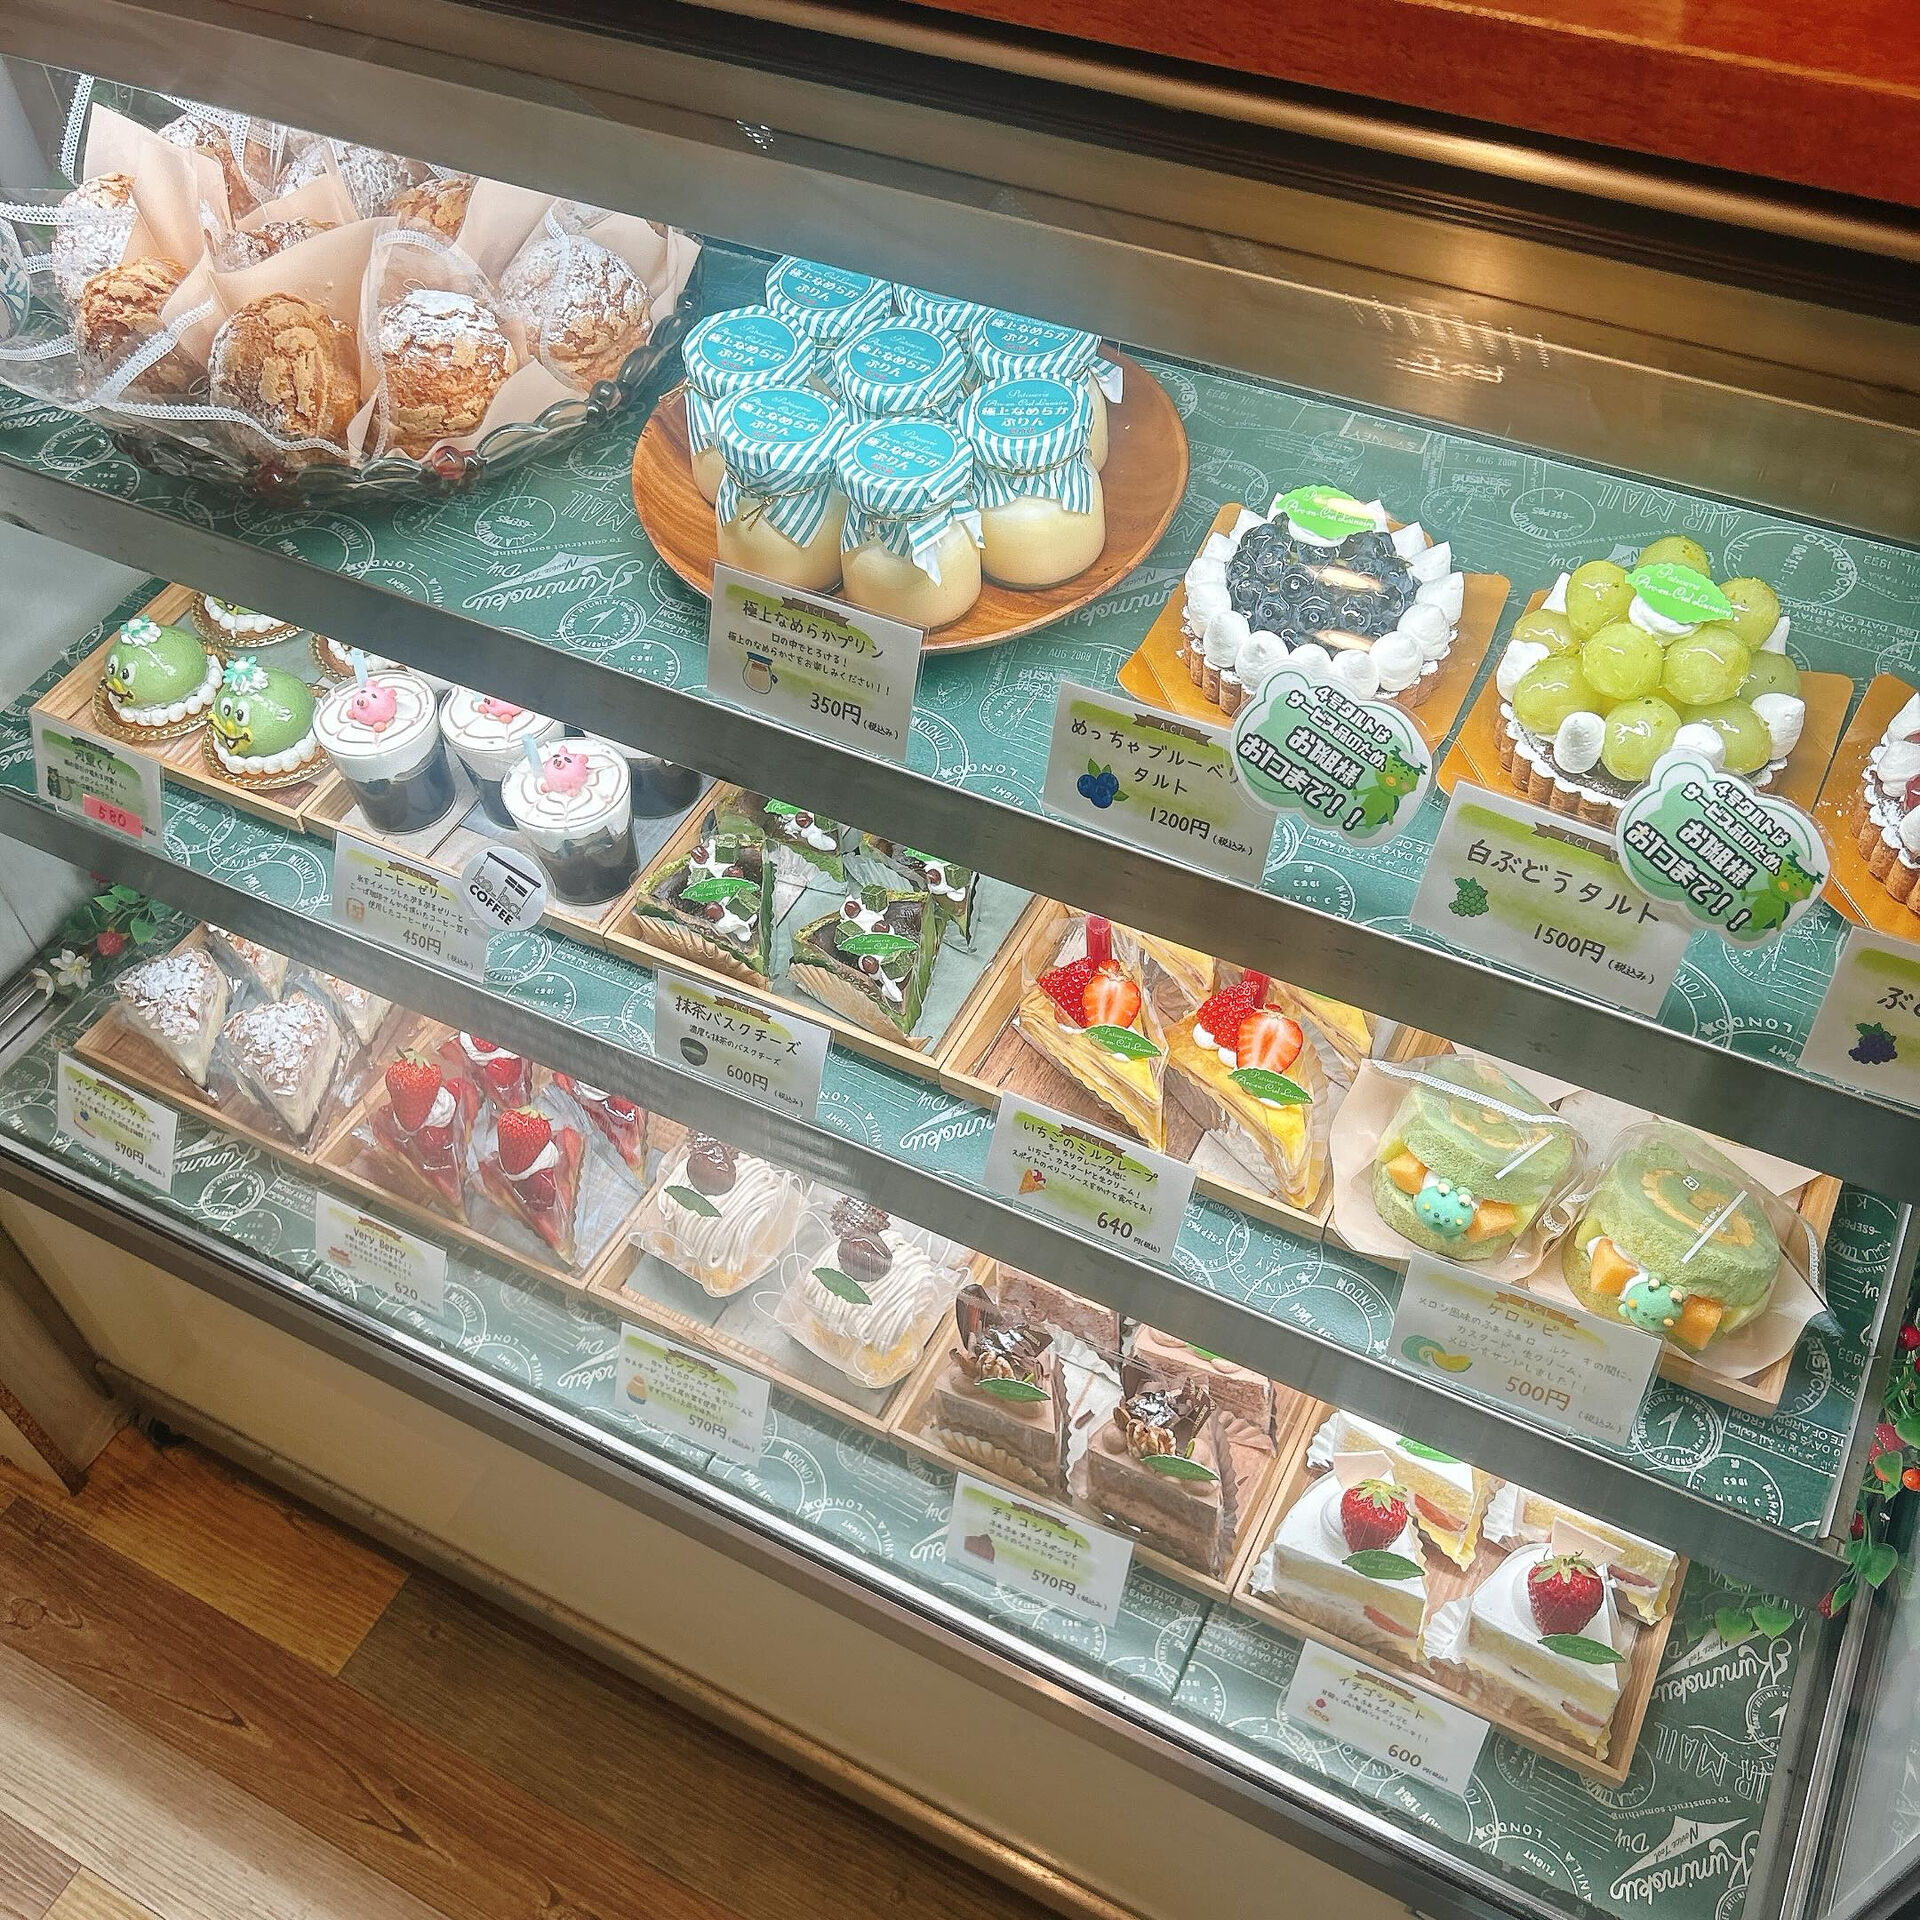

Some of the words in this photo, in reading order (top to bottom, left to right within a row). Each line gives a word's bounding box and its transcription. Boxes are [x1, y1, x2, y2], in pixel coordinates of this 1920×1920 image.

[789, 268, 861, 299] 極上なめらか
[796, 285, 831, 302] ぷりん
[990, 319, 1069, 341] 極上なめらか
[1002, 331, 1039, 348] ぷりん
[708, 333, 785, 362] 極上なめらか
[717, 350, 756, 366] ぷりん
[856, 343, 933, 374] 極上なめらか
[865, 360, 901, 377] ぷりん
[739, 401, 820, 434] 極上なめらか
[981, 406, 1069, 417] 極上なめらか
[1000, 416, 1046, 428] ぷりん
[750, 421, 791, 437] ぷりん
[864, 436, 942, 469] 極上なめらか
[871, 452, 910, 471] ぷりん
[562, 490, 629, 531] MAIL
[1597, 481, 1675, 523] MAIL
[462, 560, 645, 613] Kumimoku
[486, 563, 520, 577] Diy
[742, 600, 884, 659] 極上なめらかプリン
[727, 630, 891, 696] 極上のなめらかさをお楽しみください！！
[771, 632, 848, 667] 口の中でとろける！
[1049, 646, 1067, 660] AUG
[810, 692, 862, 726] 350円
[1315, 685, 1392, 744] 4号タルトは
[1286, 690, 1387, 773] サービス品のため、
[1286, 725, 1366, 790] お1組様
[1134, 767, 1188, 797] タルト
[99, 806, 126, 827] 580
[1681, 782, 1783, 875] サービス品のため、
[1714, 780, 1792, 847] 4号タルトは
[1150, 807, 1211, 840] 1200円
[1213, 834, 1254, 856] (税込み)
[1676, 818, 1758, 890] お1組様
[374, 866, 450, 901] コーヒーゼリー
[1467, 839, 1659, 924] 白ぶどうタルト
[469, 884, 514, 926] COFFEE
[402, 929, 442, 956] 450円
[1534, 924, 1606, 963] 1500円
[1608, 959, 1655, 985] (税込み)
[676, 995, 802, 1056] 抹茶バスクチーズ
[689, 1024, 782, 1066] 濃厚な抹茶のバスクチーズ
[726, 1064, 769, 1092] 600円
[917, 1091, 949, 1111] Diy
[114, 1141, 144, 1165] 570円
[1023, 1121, 1159, 1183] いちごのミルクレープ
[1048, 1143, 1127, 1181] もっちりクレープ生地に
[1012, 1150, 1153, 1215] スポイトのベリーソースをかけて食べてね！
[1027, 1145, 1141, 1199] いちご、カスタードと生クリーム！
[1097, 1211, 1133, 1239] 640
[353, 1226, 375, 1244] Very
[379, 1239, 406, 1260] Berry
[394, 1281, 418, 1300] 620
[1335, 1275, 1382, 1320] LONDON
[1487, 1302, 1576, 1341] ケロッピー
[664, 1353, 720, 1383] モンブラン
[1505, 1376, 1571, 1412] 500円
[688, 1414, 727, 1439] 570円
[991, 1506, 1083, 1549] チョコショート
[1031, 1569, 1075, 1596] 570円
[1339, 1677, 1424, 1720] イチゴショート
[1388, 1744, 1422, 1767] 600
[1654, 1721, 1730, 1787] MAIL
[1614, 1828, 1649, 1854] Diy
